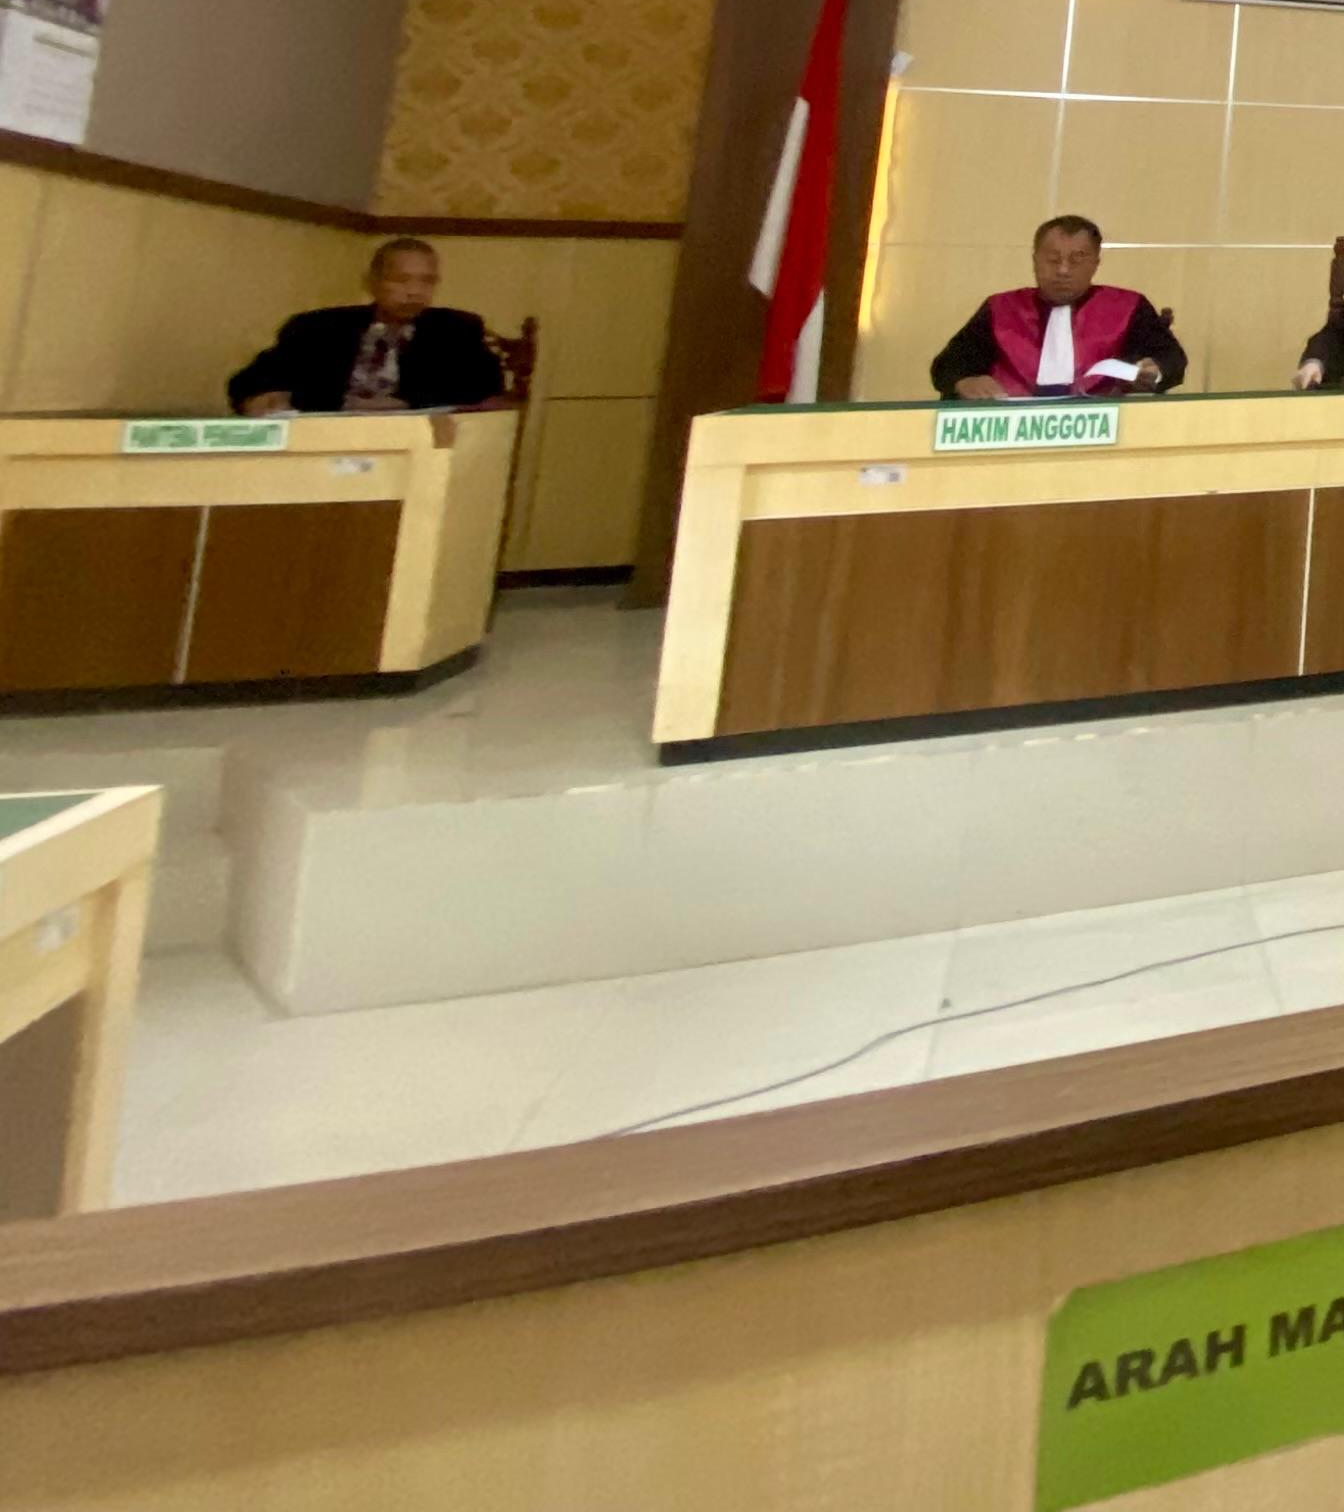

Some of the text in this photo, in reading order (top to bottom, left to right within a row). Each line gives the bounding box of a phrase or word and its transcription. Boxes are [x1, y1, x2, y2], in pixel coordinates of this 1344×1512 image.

[941, 413, 1111, 444] HAKIM ANGGOTA
[1067, 1324, 1247, 1411] ARAH
